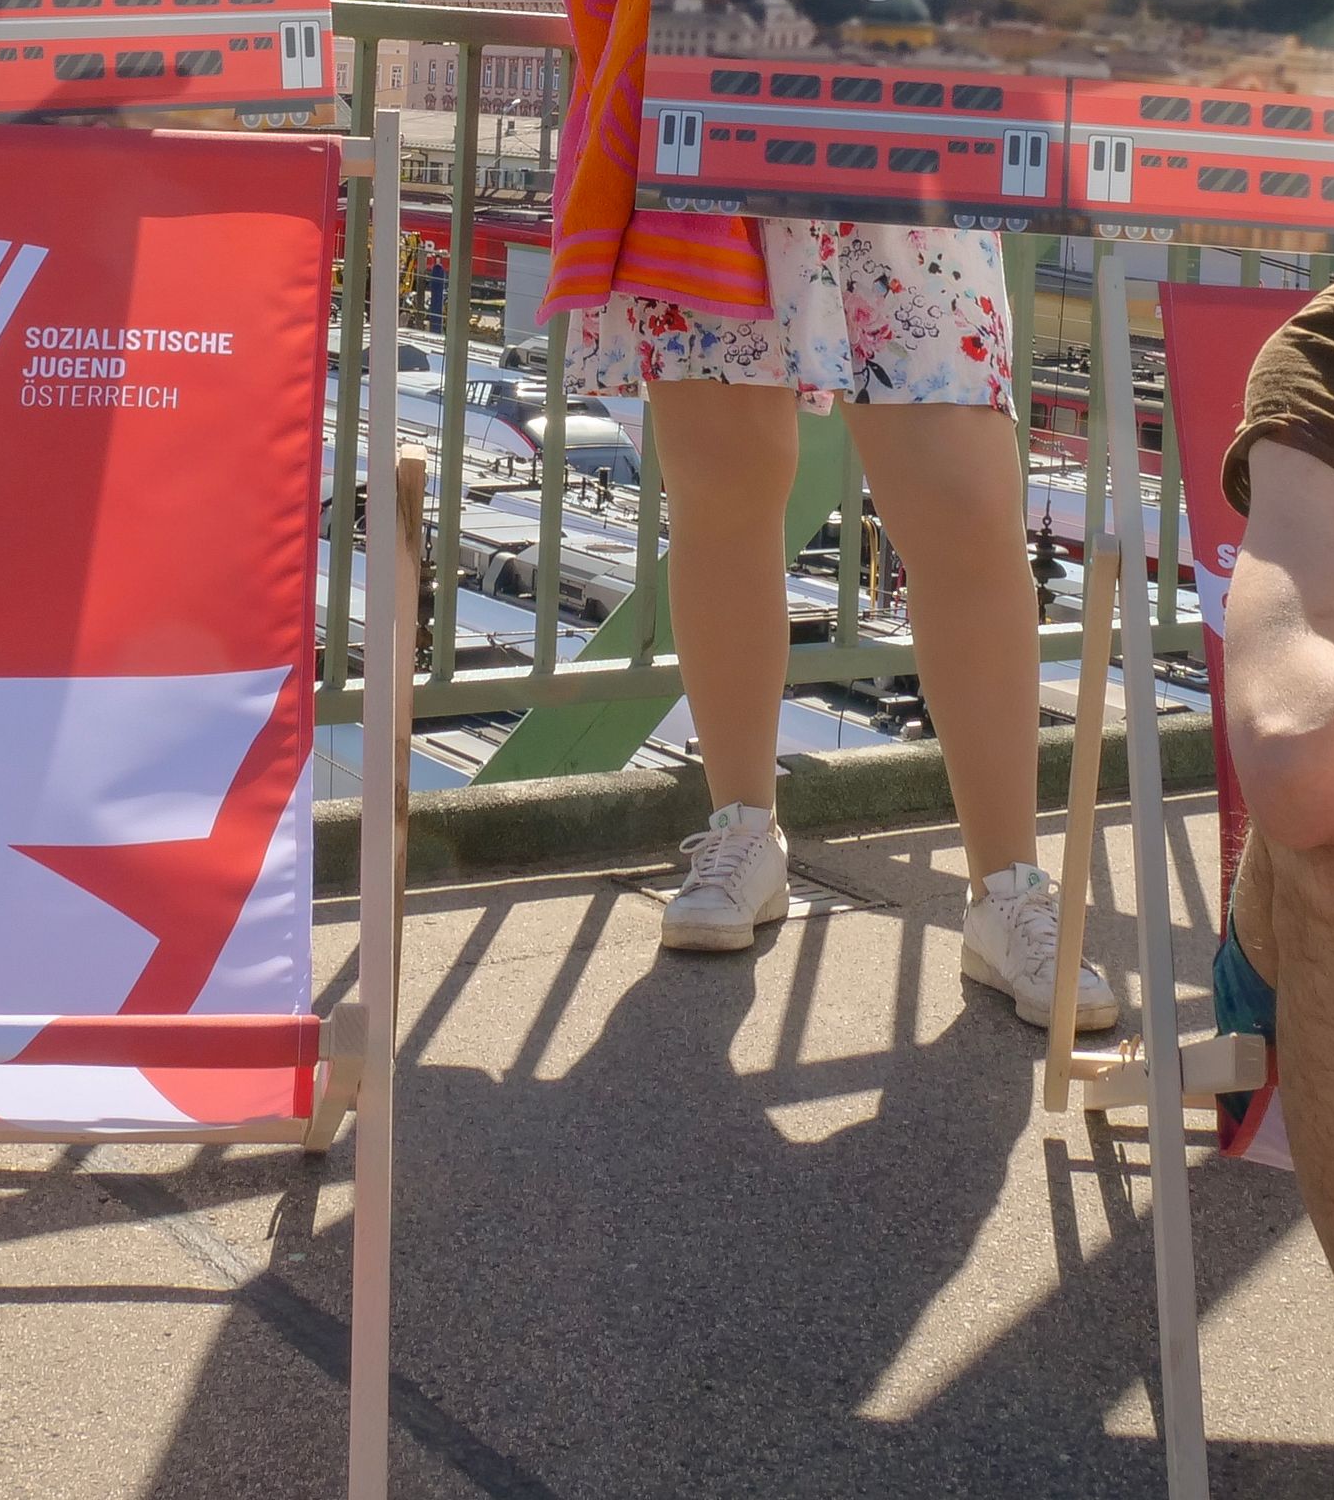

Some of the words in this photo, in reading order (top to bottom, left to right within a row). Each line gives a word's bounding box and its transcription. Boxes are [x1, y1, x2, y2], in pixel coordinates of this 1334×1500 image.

[24, 326, 234, 356] SOZIALISTISCHE
[21, 356, 127, 380] JUGEND
[20, 379, 179, 410] ÖSTERREICH
